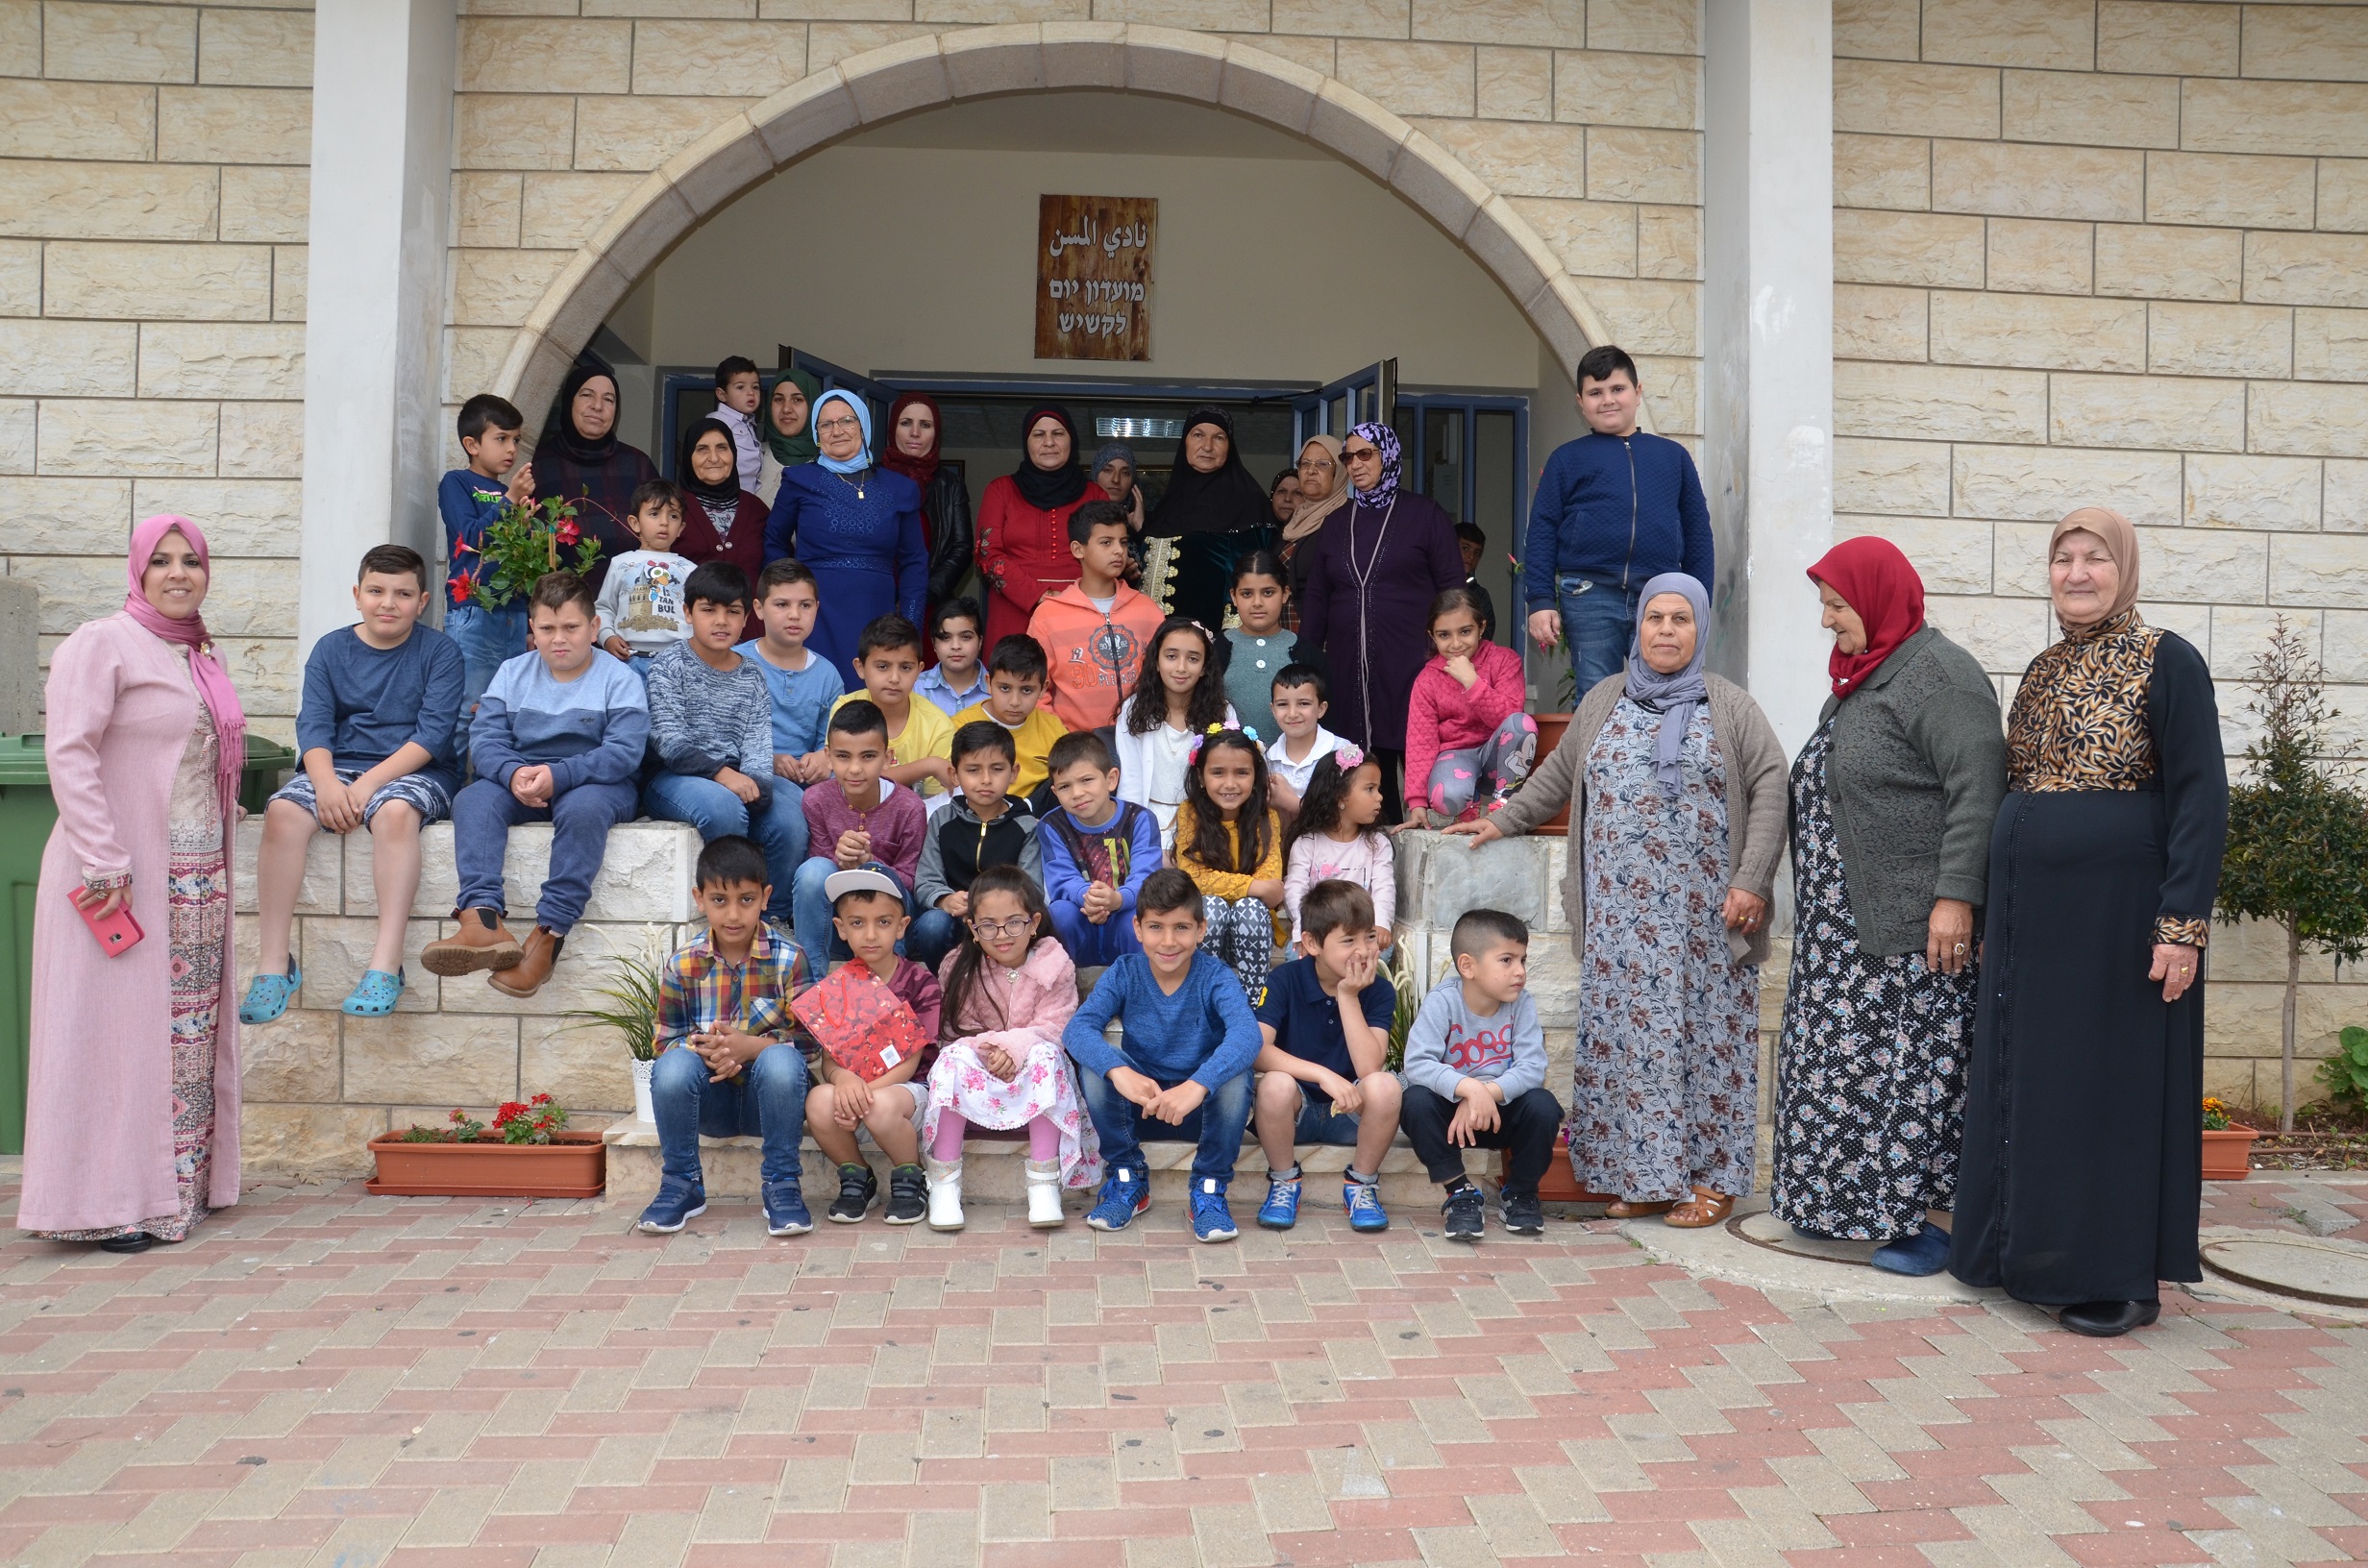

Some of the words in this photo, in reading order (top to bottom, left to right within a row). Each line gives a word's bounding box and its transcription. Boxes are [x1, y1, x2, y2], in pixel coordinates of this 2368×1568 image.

[1049, 214, 1097, 257] المسن
[1102, 220, 1147, 259] نادي
[1048, 278, 1079, 299] יום
[1085, 279, 1145, 306] מועדון
[1059, 309, 1127, 339] לקשיש
[657, 603, 676, 614] BUL
[658, 596, 675, 605] TAN
